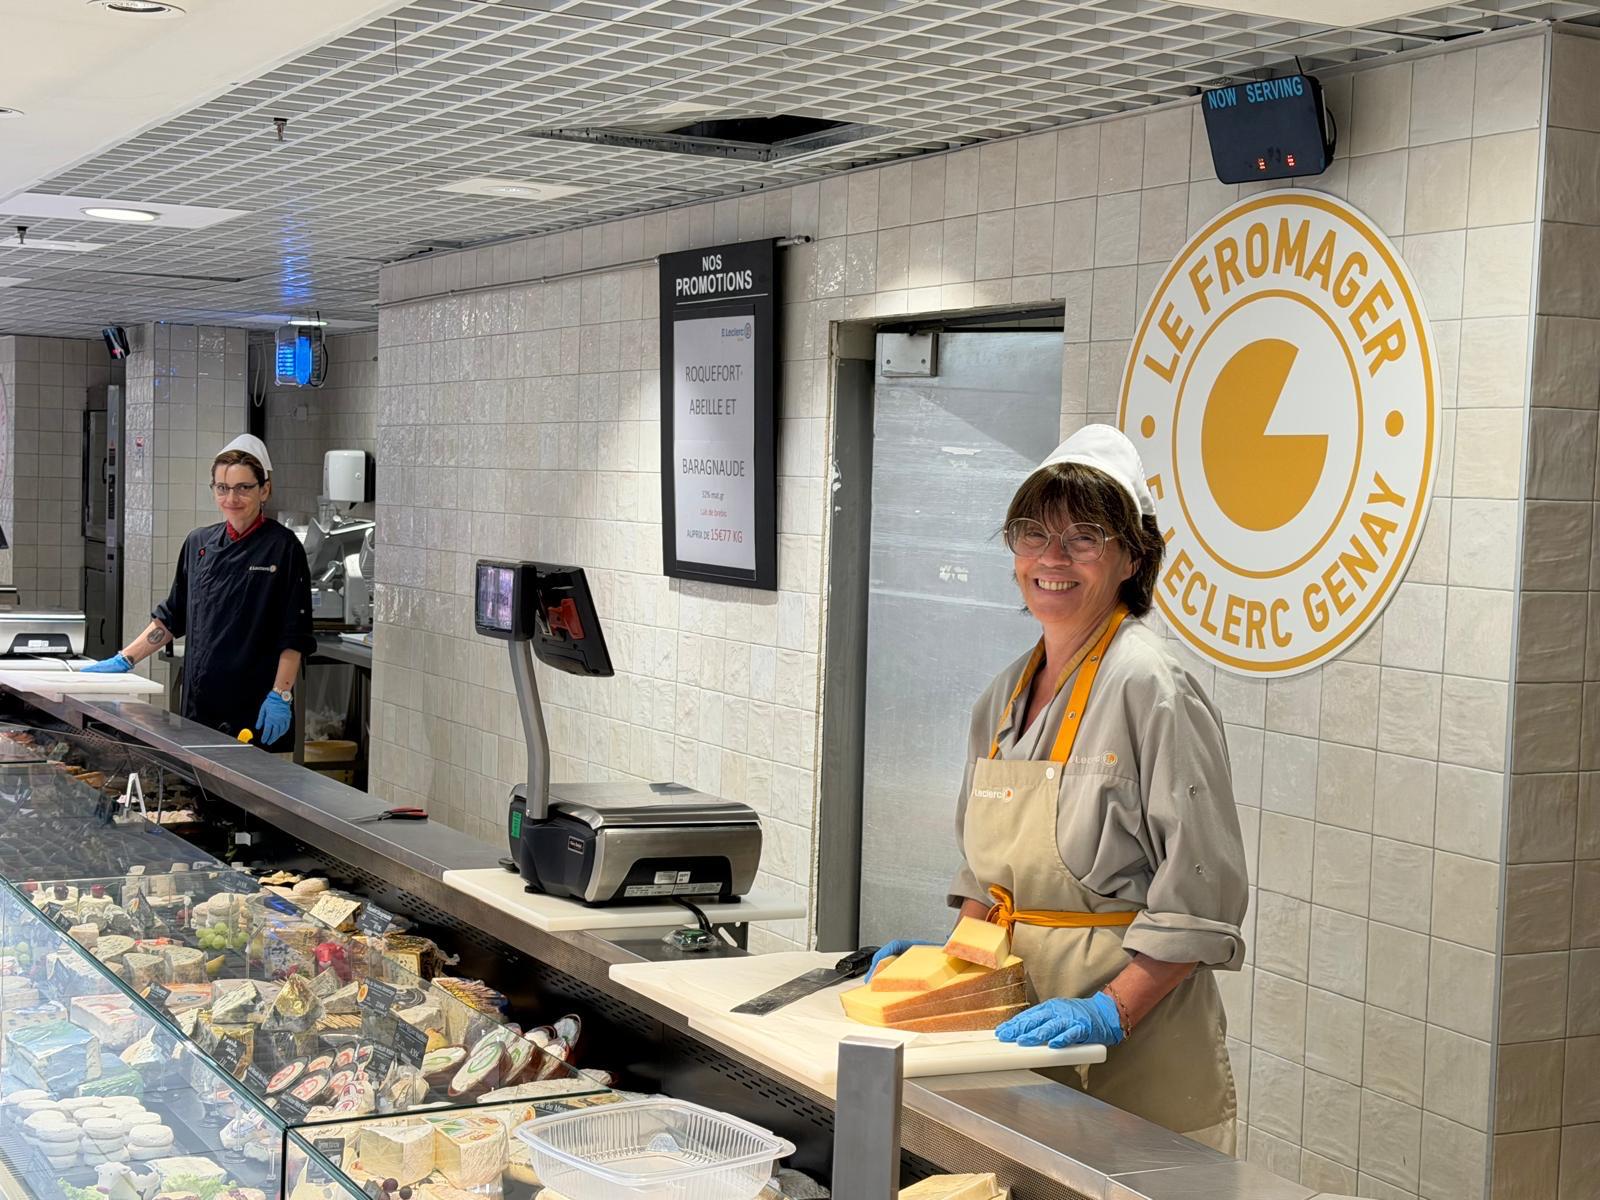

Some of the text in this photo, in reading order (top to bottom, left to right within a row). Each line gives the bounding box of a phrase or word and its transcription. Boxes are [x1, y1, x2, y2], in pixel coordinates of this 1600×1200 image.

[1207, 76, 1303, 109] NOW SERVING
[702, 254, 722, 271] NOS
[675, 269, 753, 296] PROMOTIONS
[1143, 217, 1407, 385] LE FROMAGER
[689, 398, 737, 416] ABEILLE ET
[682, 458, 745, 478] BARAGNAUDE
[732, 530, 743, 543] KG
[1302, 471, 1407, 633] GENAY
